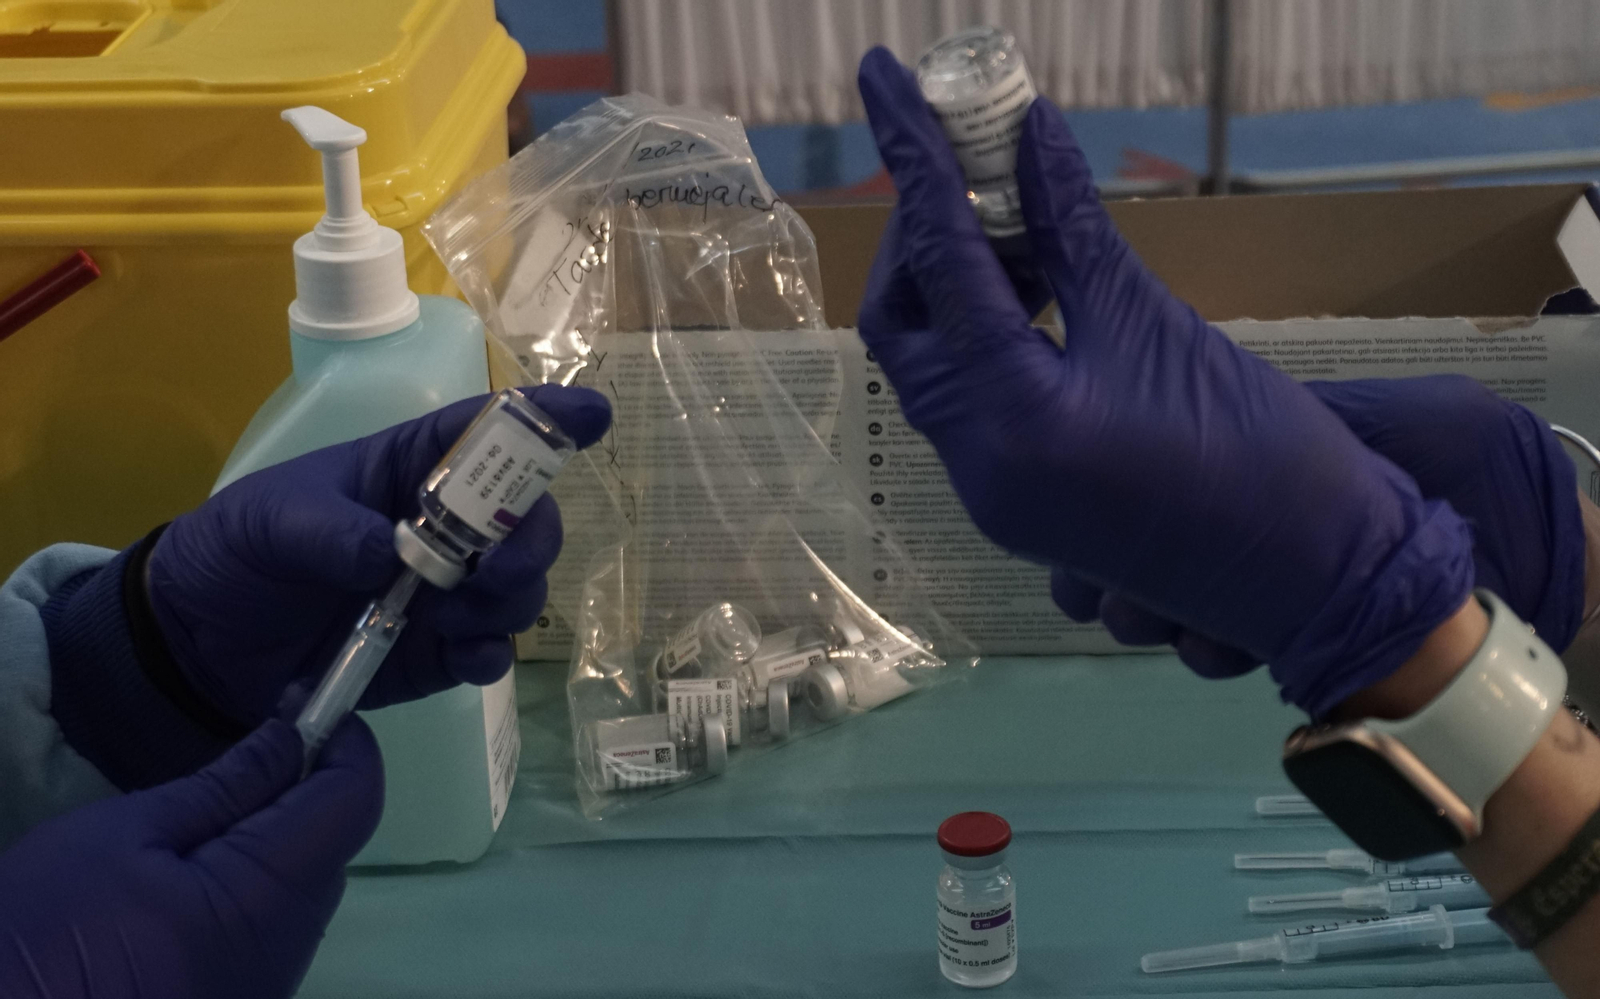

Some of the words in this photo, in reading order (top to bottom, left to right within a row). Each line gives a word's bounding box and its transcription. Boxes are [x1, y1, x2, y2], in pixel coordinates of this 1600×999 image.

[464, 444, 502, 487] 06-2021
[724, 694, 733, 727] COVID-19
[612, 749, 650, 758] AstraZeneca
[969, 902, 1012, 919] AstraZeneca
[974, 921, 981, 929] 5
[948, 946, 959, 954] use
[951, 956, 962, 965] (10
[968, 959, 980, 967] 0.5
[980, 959, 990, 967] ml
